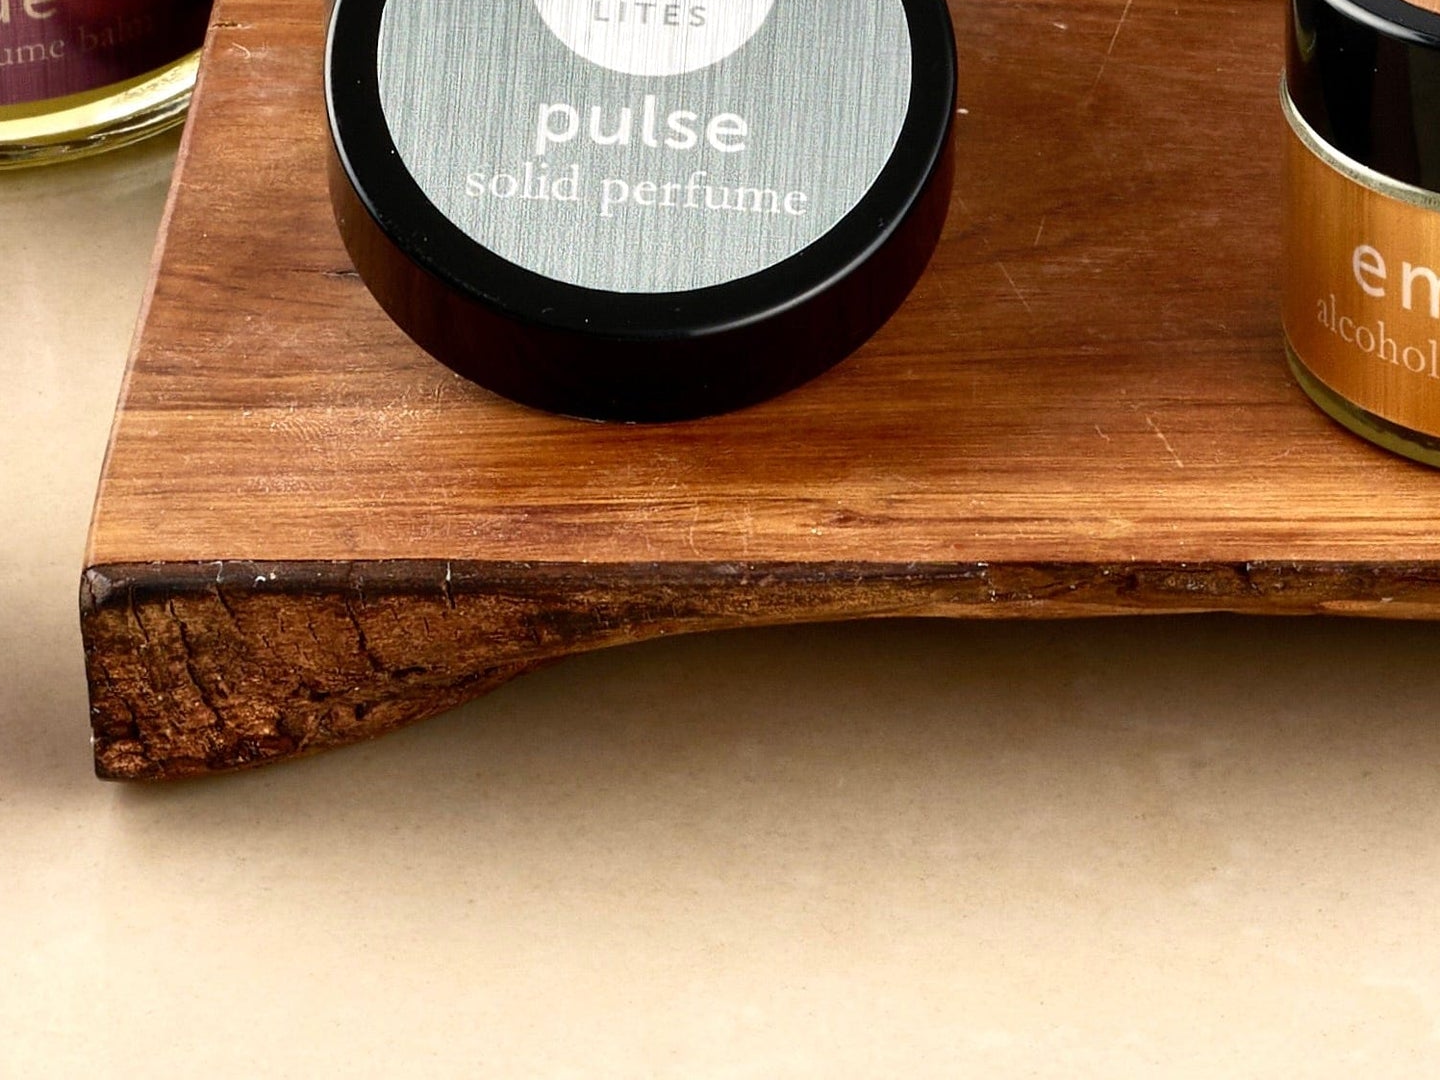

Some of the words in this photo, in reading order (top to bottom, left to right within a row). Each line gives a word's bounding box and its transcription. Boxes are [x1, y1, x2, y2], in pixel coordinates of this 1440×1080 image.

[594, 0, 706, 27] LITES
[536, 94, 748, 155] pulse
[465, 162, 580, 202] solid
[601, 170, 808, 218] perfume
[1316, 296, 1439, 379] alcohol
